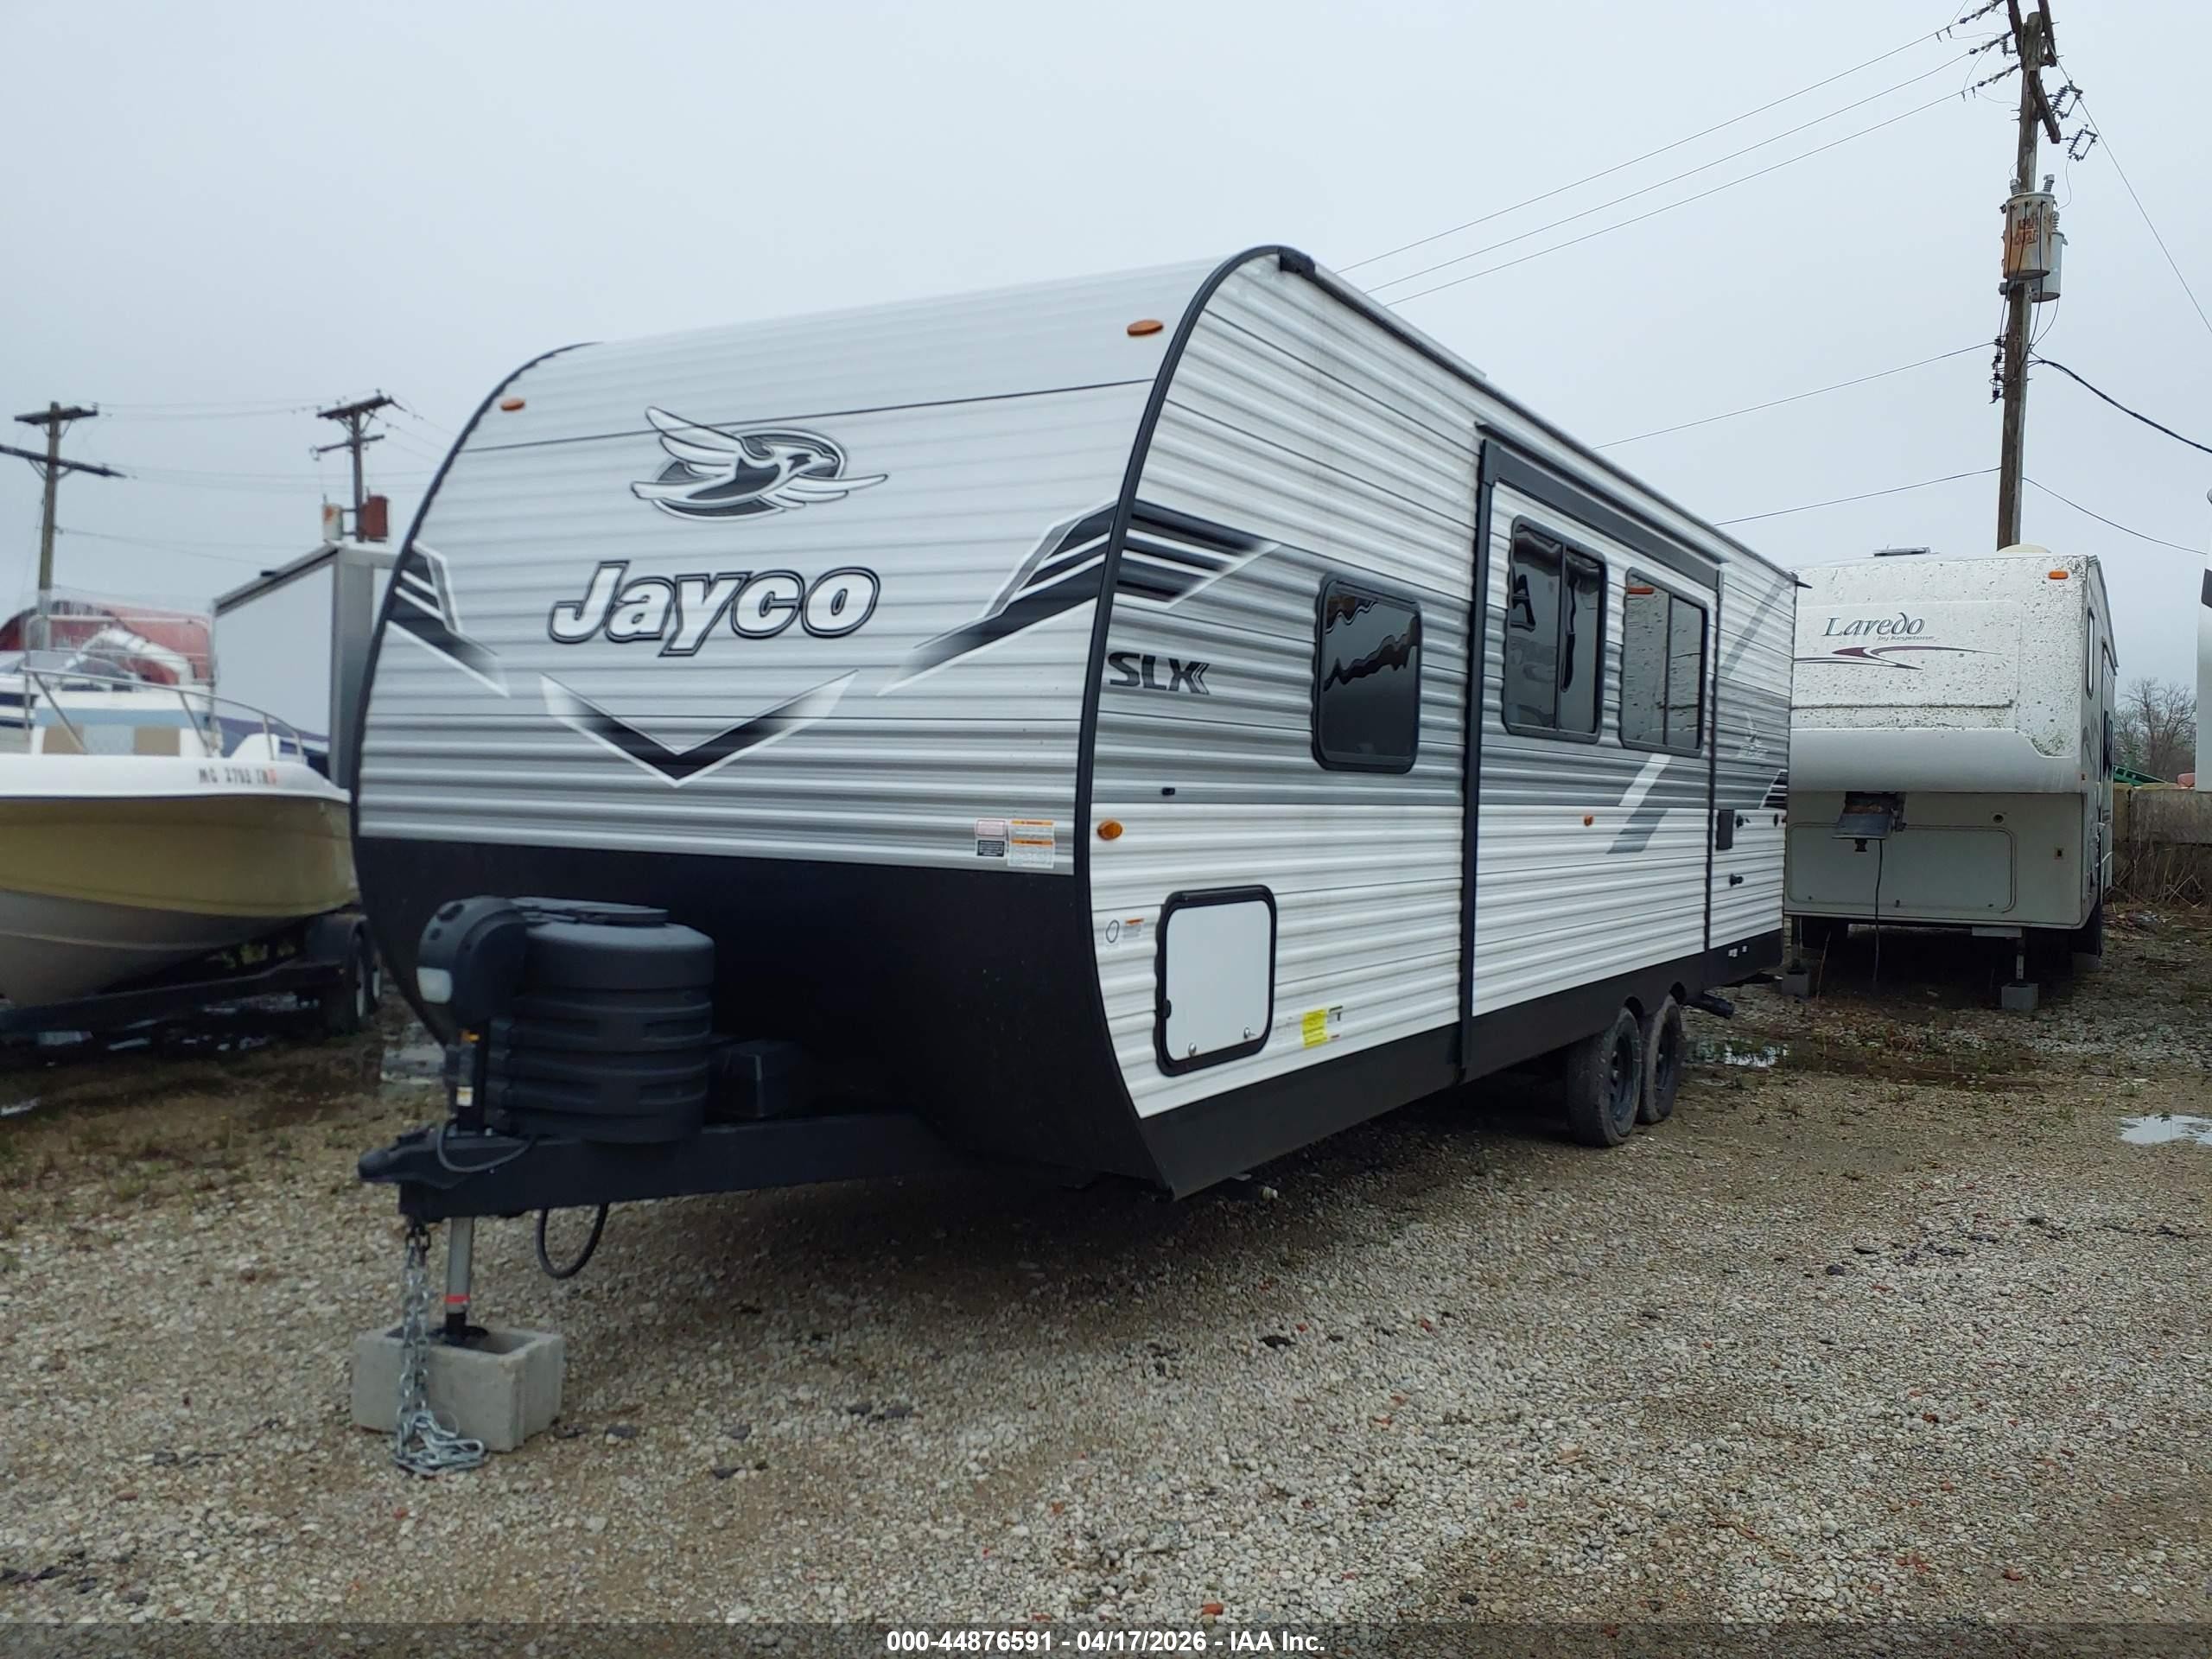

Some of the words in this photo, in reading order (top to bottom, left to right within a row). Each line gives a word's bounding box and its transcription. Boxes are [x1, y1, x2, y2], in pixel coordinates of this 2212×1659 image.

[547, 558, 881, 658] Jayco
[1821, 612, 1926, 637] Laredo
[1108, 651, 1209, 696] SLX
